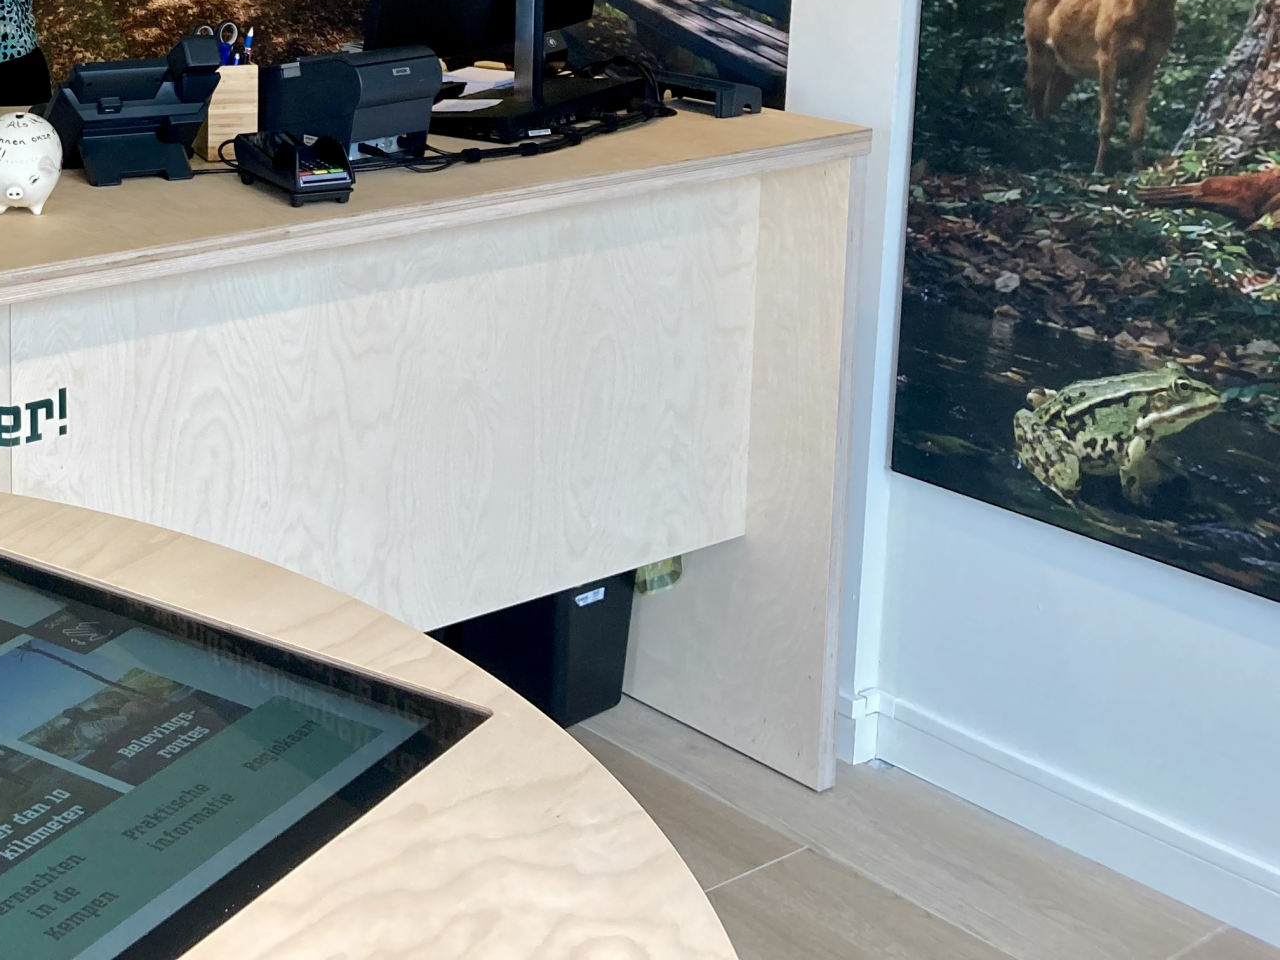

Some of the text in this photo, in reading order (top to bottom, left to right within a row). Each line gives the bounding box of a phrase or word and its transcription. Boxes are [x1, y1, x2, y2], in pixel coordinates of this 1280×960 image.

[5, 120, 29, 129] Als
[117, 710, 196, 758] Belevings-
[156, 725, 210, 759] routes
[12, 801, 51, 826] dan
[44, 788, 71, 805] 10
[121, 781, 211, 842] Praktische
[146, 792, 236, 853] informatie
[26, 885, 82, 920] in de
[43, 889, 119, 941] Kempen
